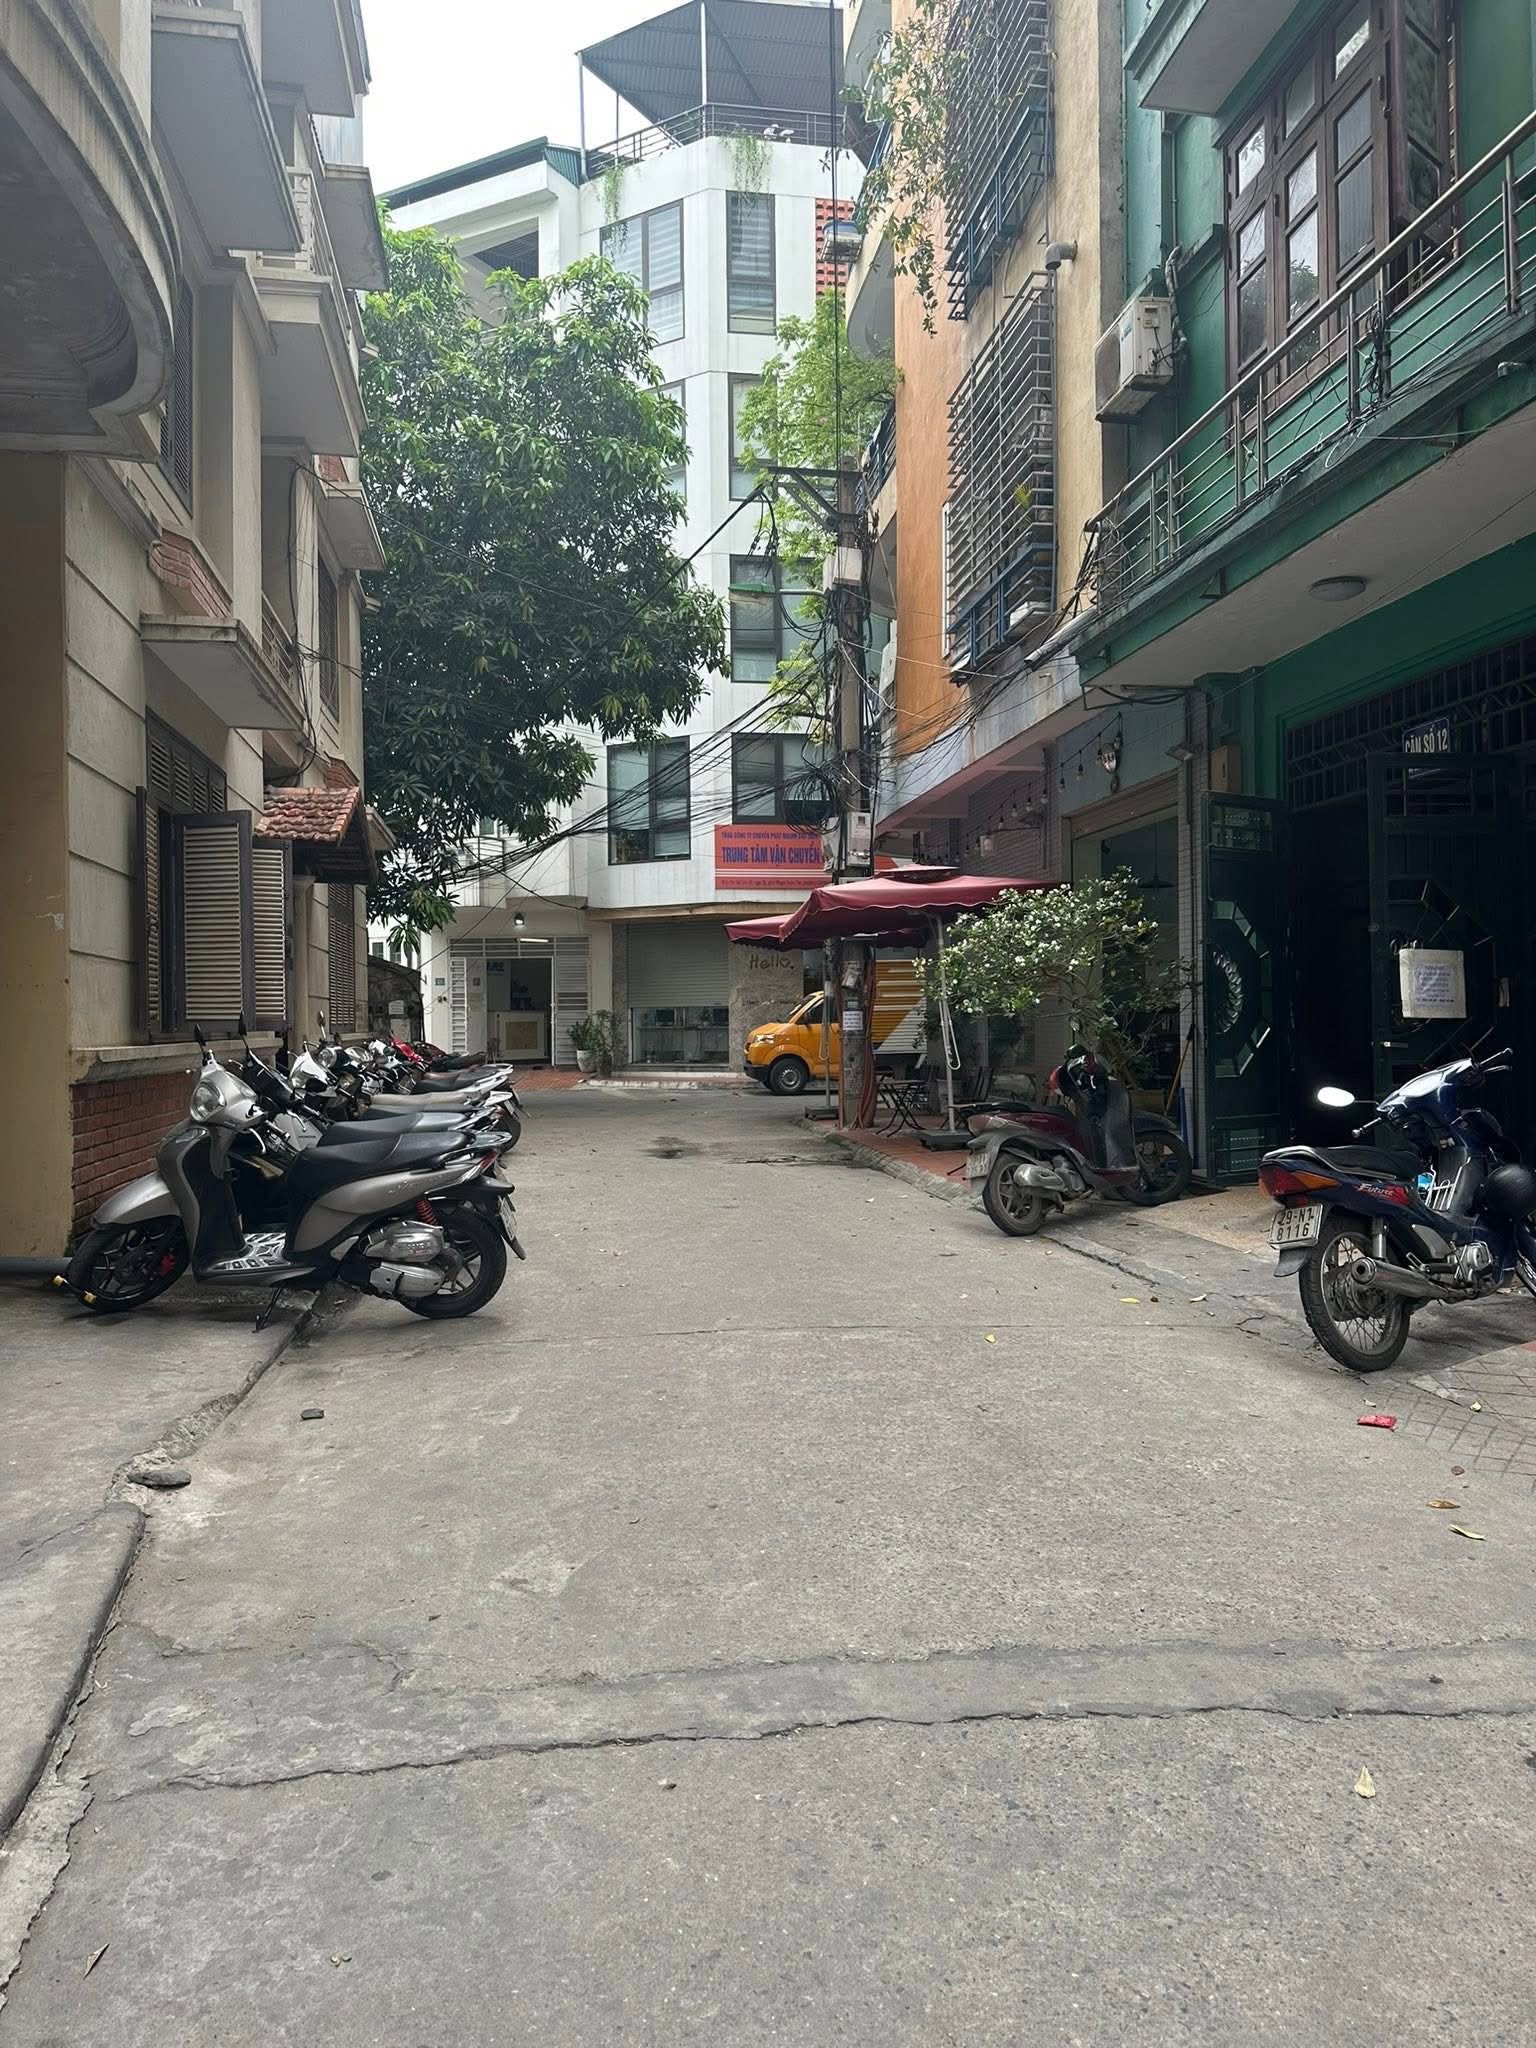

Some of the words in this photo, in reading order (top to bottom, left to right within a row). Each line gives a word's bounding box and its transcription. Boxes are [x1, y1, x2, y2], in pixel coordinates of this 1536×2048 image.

[1437, 728, 1447, 751] 12
[722, 847, 748, 864] TRUNG
[751, 844, 768, 864] TÂM
[770, 844, 786, 867] VẬN
[788, 841, 820, 864] CHUYỂN
[1276, 1223, 1310, 1241] 8116
